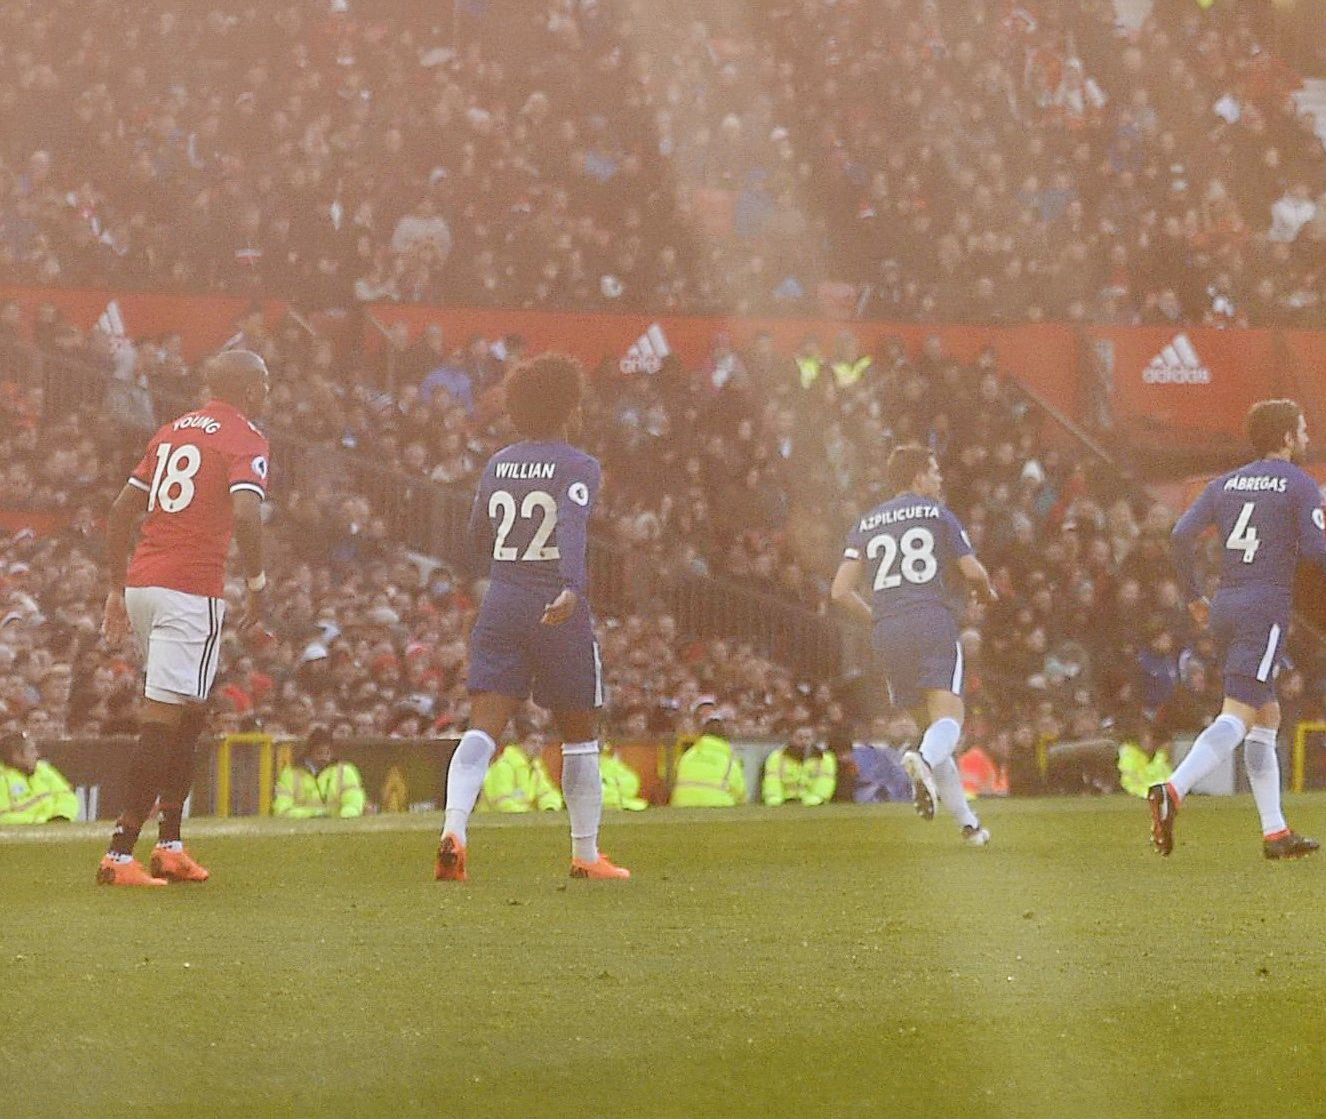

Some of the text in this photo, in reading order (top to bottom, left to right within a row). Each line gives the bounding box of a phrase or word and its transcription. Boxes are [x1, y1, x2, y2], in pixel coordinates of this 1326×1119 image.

[172, 415, 222, 434] YOUNG
[147, 442, 201, 513] 18
[494, 462, 556, 479] WILLIAN
[488, 490, 561, 561] 22
[859, 505, 940, 533] AZPILICUETA
[1225, 501, 1261, 564] 4
[866, 526, 938, 591] 28
